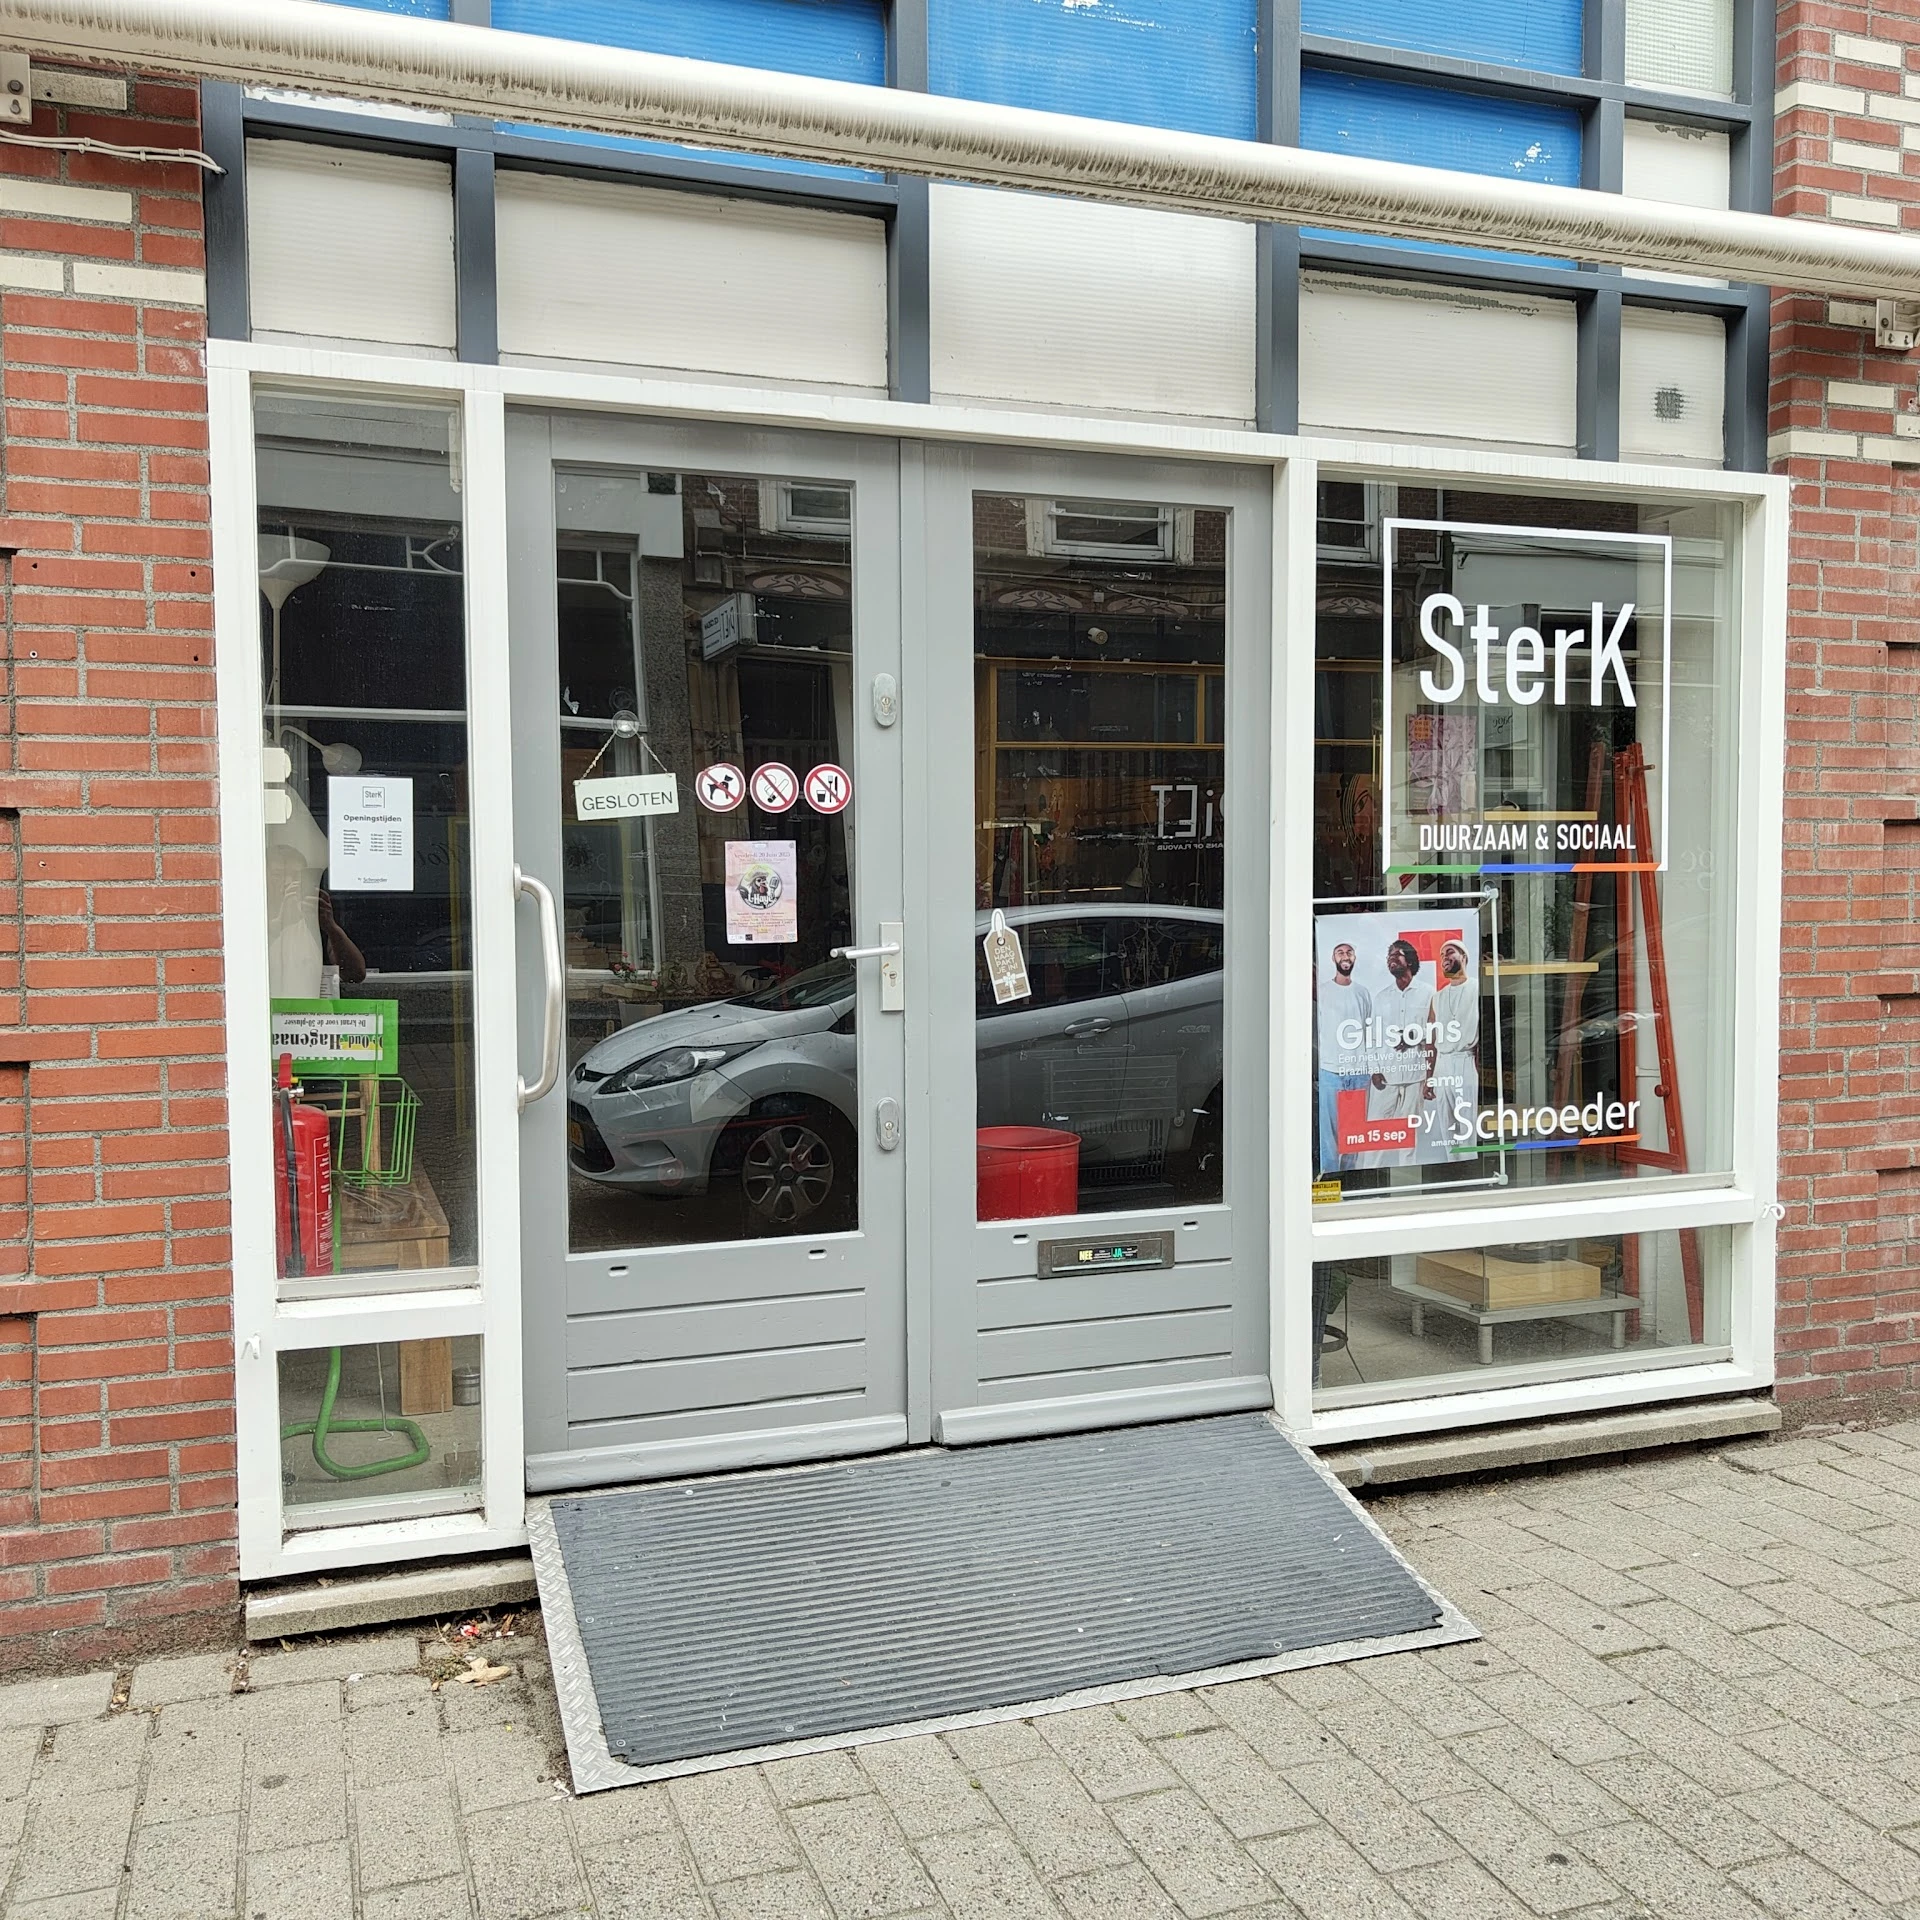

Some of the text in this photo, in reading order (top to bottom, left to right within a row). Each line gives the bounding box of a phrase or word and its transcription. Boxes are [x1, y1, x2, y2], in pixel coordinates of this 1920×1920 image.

[1419, 592, 1637, 707] SterK
[364, 790, 383, 799] SterK
[582, 791, 673, 811] GESLOTEN
[343, 814, 402, 823] Openingstijden
[1419, 823, 1637, 851] DUURZAAM & SOCIAAL
[994, 945, 1011, 955] DEN
[994, 950, 1015, 961] HAAG
[995, 957, 1015, 968] PAKT
[996, 962, 1018, 975] JE IN!
[284, 1018, 316, 1028] 50-plusser
[340, 1019, 357, 1027] krant
[358, 1019, 367, 1028] De
[1336, 1016, 1462, 1050] Gilsons
[1338, 1049, 1434, 1064] Een nieuwe golf van
[1338, 1062, 1432, 1077] Braziliaanse muziek
[1453, 1092, 1641, 1141] Schroeder
[1347, 1130, 1407, 1145] ma 15 sep
[1079, 1250, 1093, 1260] NEE
[1112, 1248, 1122, 1258] JA
